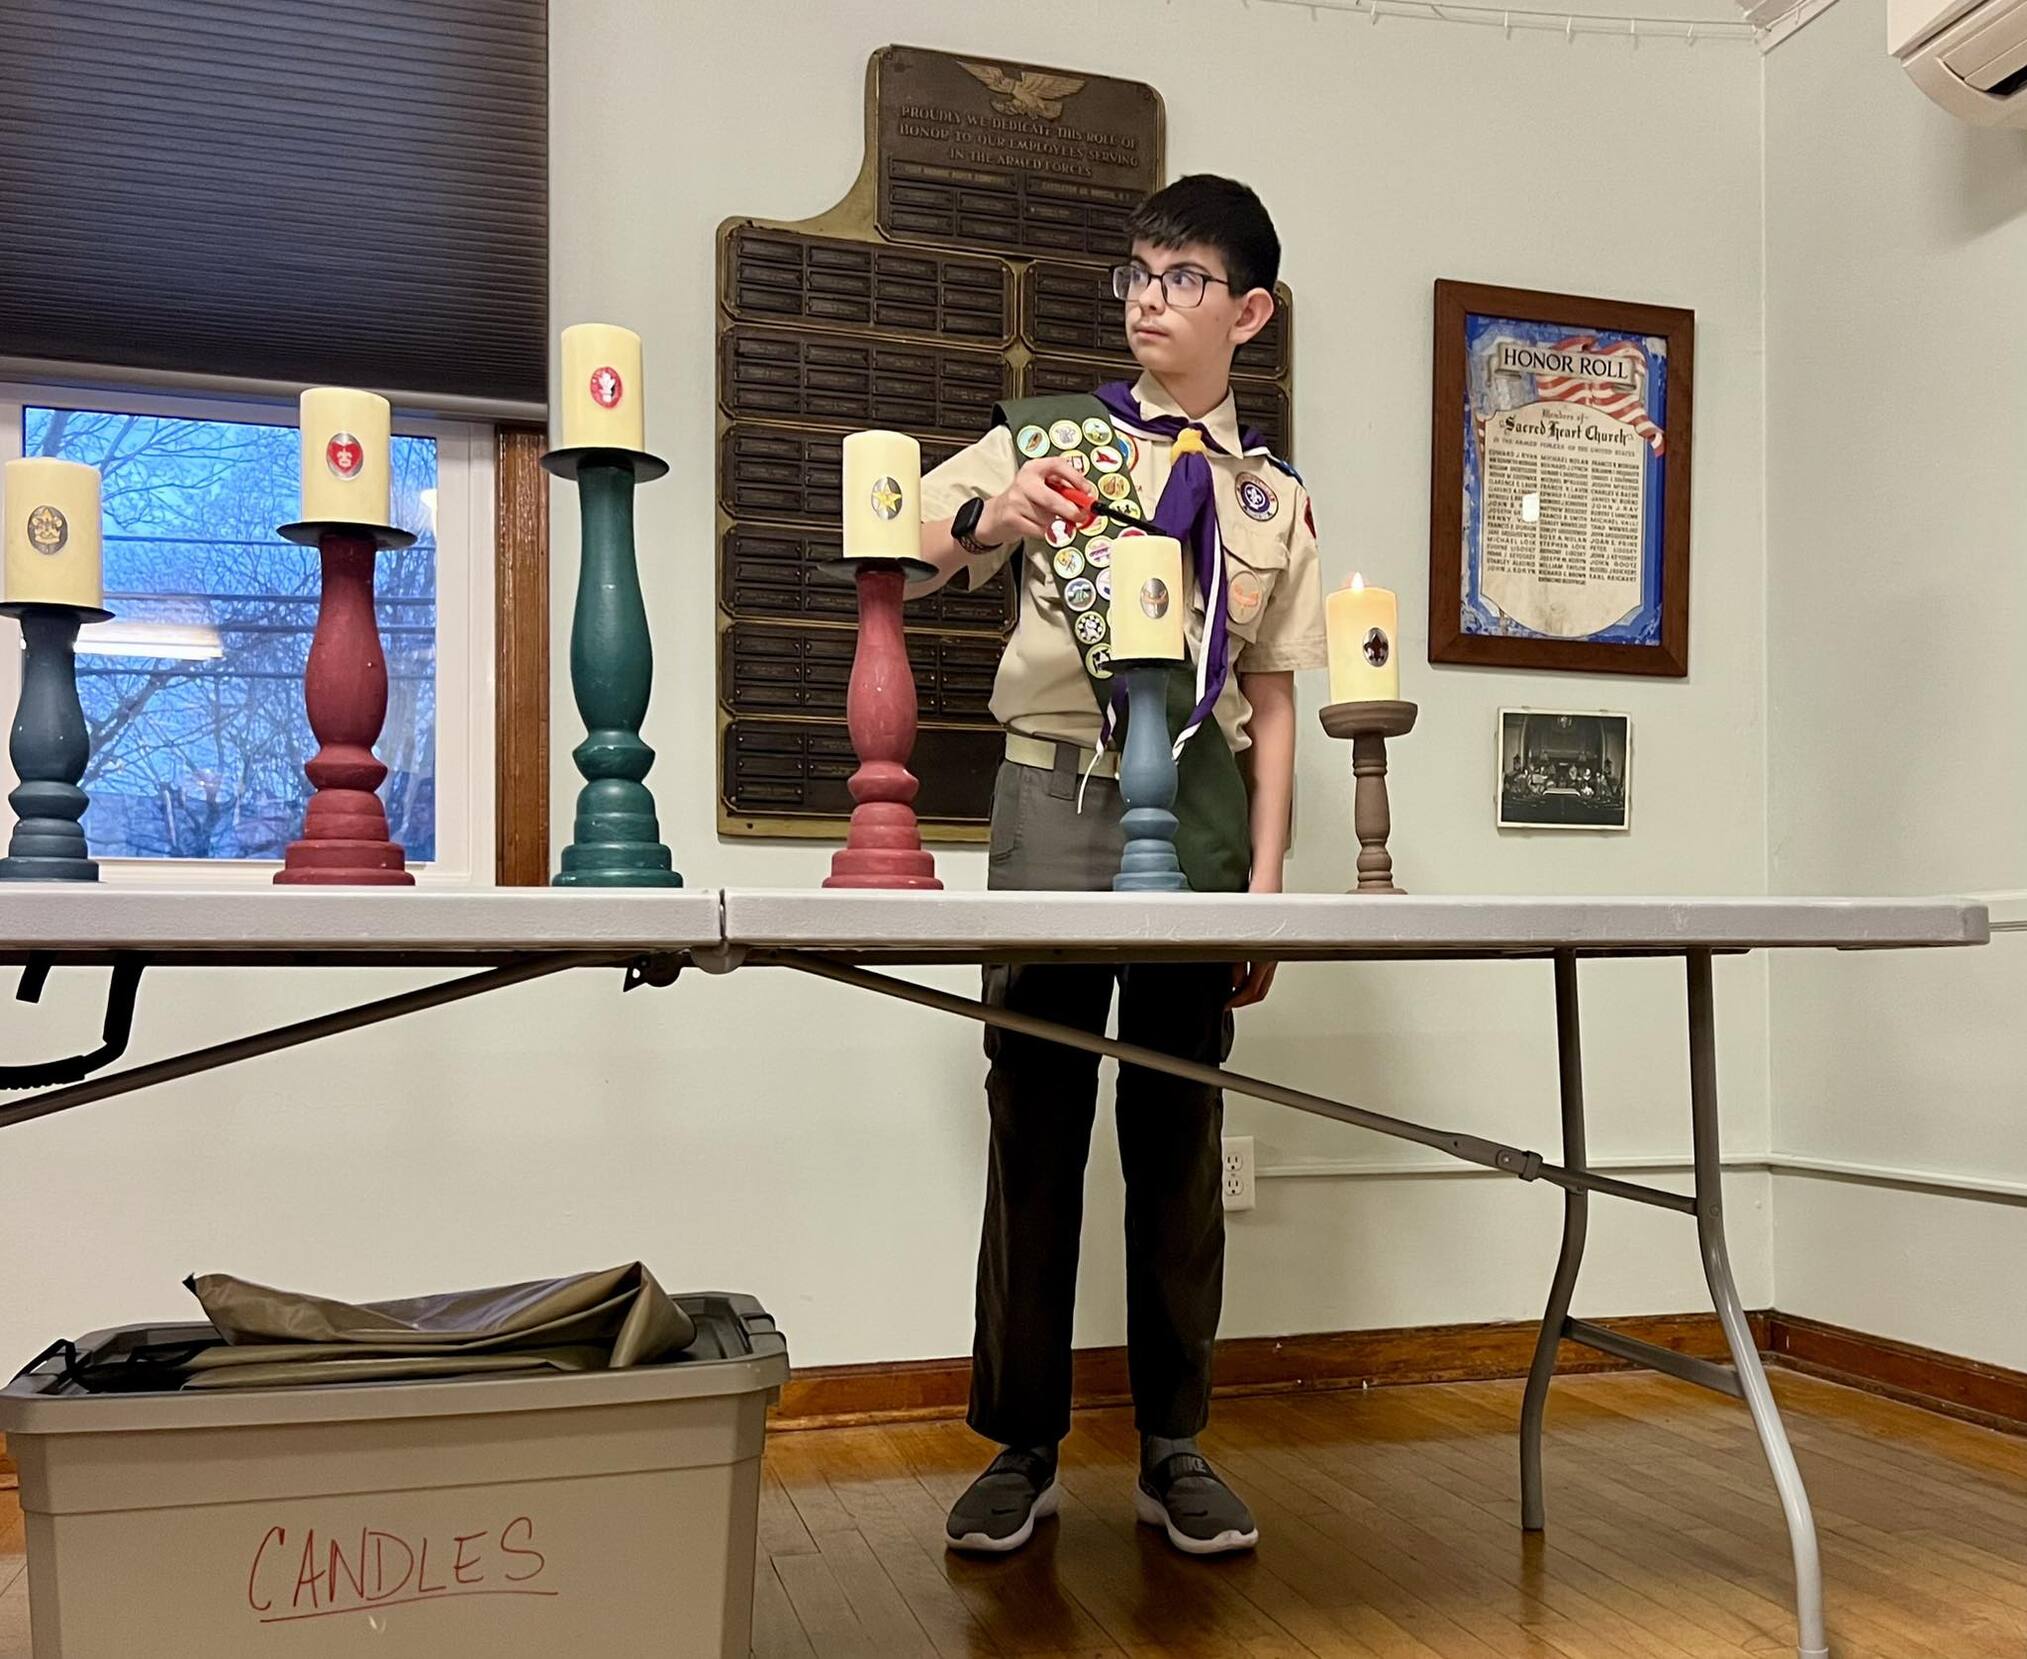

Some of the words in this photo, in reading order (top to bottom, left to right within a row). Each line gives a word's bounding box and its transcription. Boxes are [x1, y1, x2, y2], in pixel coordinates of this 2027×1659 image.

[899, 124, 949, 140] HONOR
[954, 130, 971, 143] TO
[977, 133, 1006, 148] OUR
[1009, 137, 1084, 160] EMPLOYEES
[1087, 149, 1139, 168] SERVING
[901, 104, 962, 125] PROUDLY
[967, 114, 986, 128] WE
[992, 118, 1054, 138] DEDICATE
[1056, 127, 1082, 141] THIS
[1086, 132, 1118, 146] ROLL
[1120, 137, 1137, 150] OF
[949, 148, 965, 160] IN
[970, 152, 993, 164] THE
[998, 155, 1042, 171] ARMED
[1042, 160, 1094, 178] FORCES
[1505, 347, 1574, 374] HONOR
[1580, 357, 1629, 380] ROLL
[1504, 415, 1546, 436] Sacred
[1547, 420, 1582, 439] Heart
[1585, 425, 1628, 446] Church
[249, 1516, 545, 1611] CANDLES
